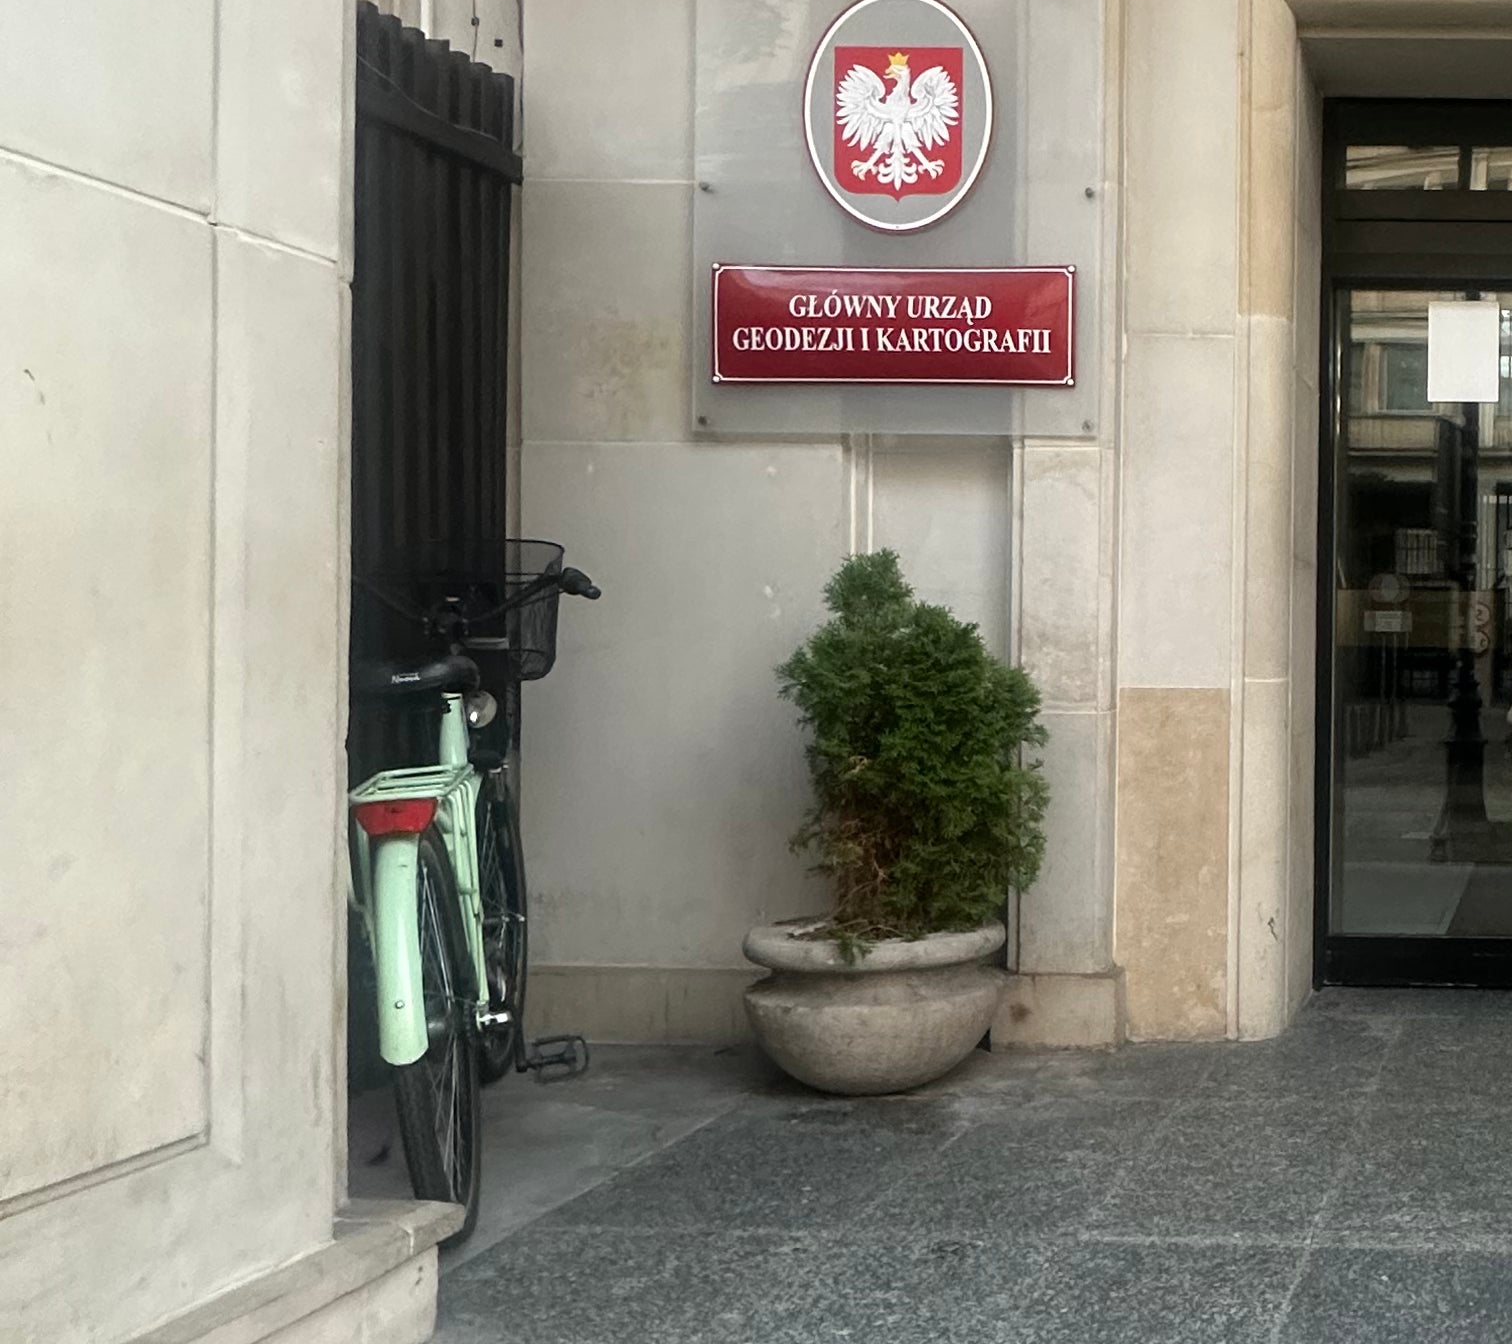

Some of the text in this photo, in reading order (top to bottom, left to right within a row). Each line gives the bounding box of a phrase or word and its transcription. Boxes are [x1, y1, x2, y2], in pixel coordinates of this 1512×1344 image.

[788, 290, 993, 326] GŁÓWNY URZĄD
[732, 327, 1052, 354] GEODEZJI I KARTOGRAFII
